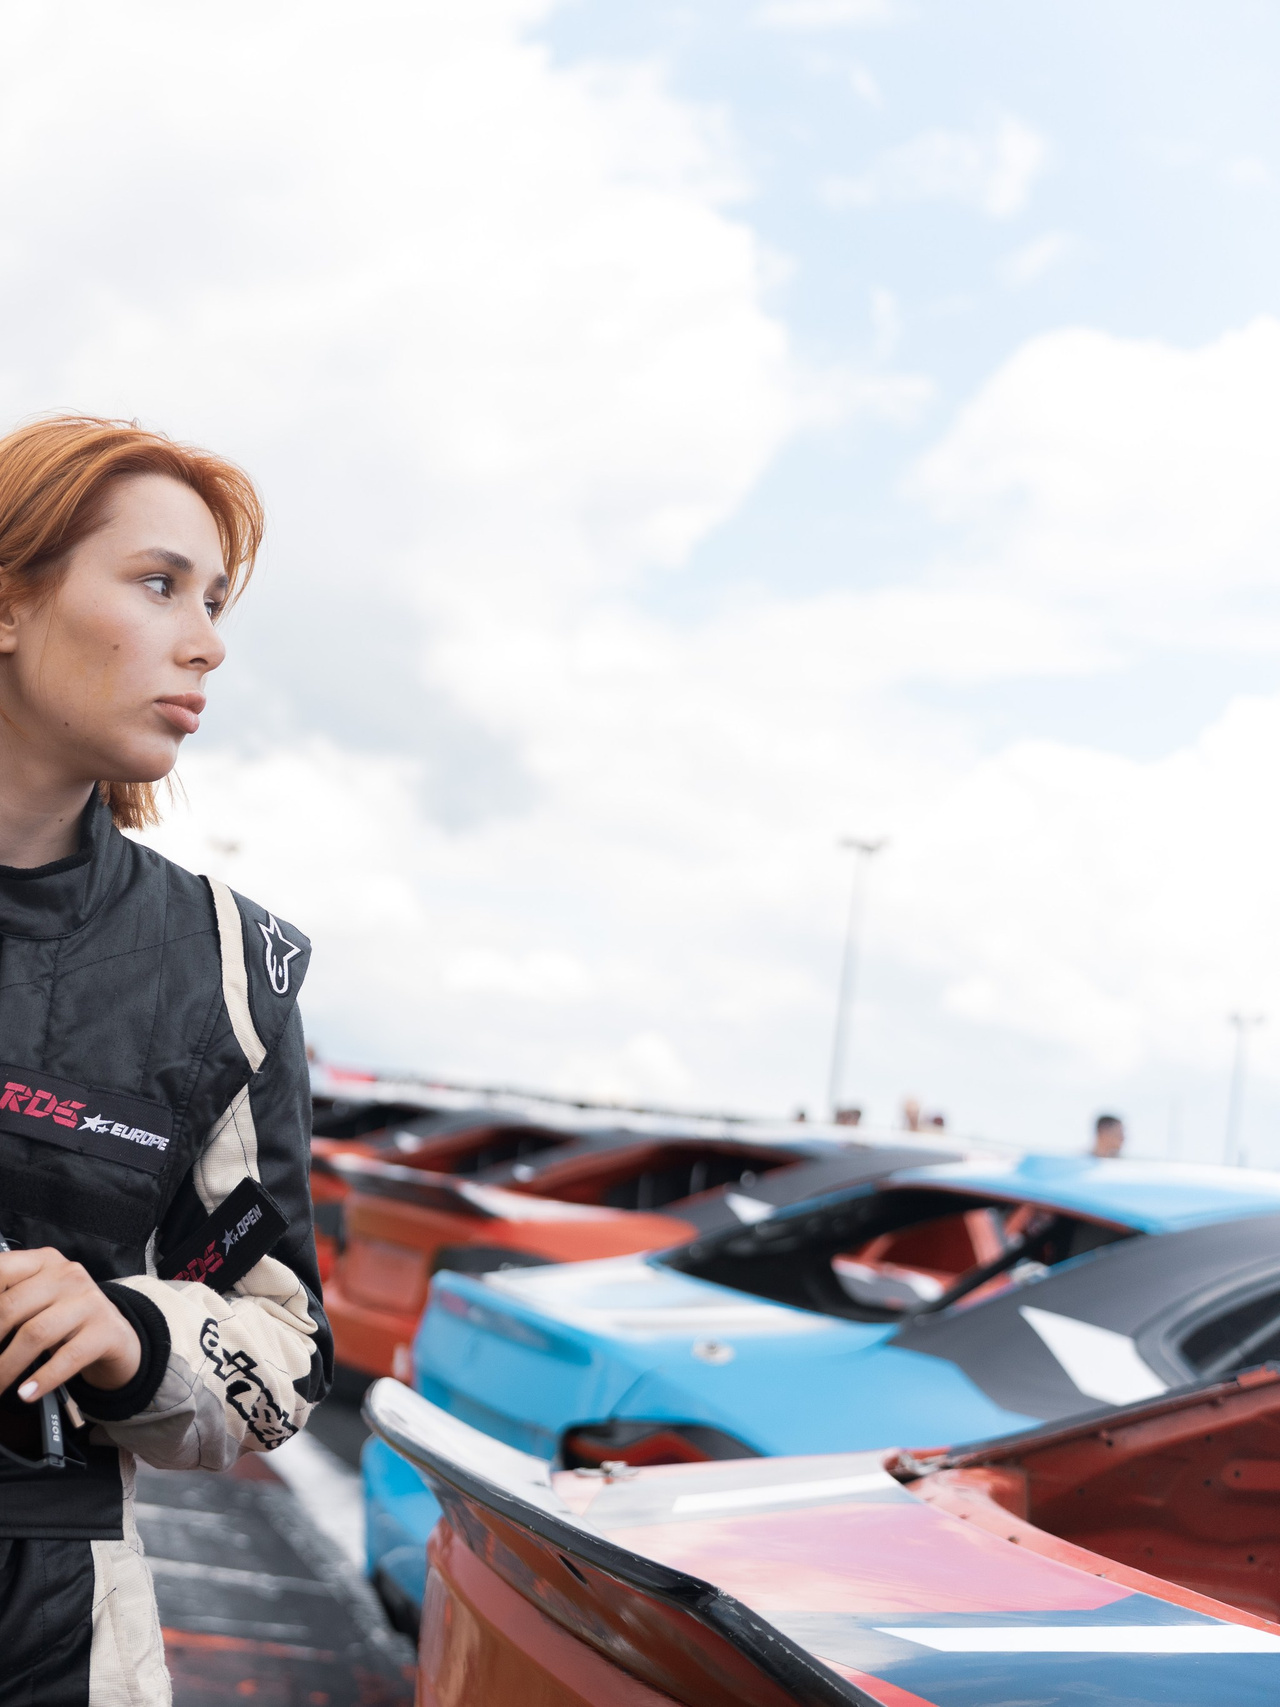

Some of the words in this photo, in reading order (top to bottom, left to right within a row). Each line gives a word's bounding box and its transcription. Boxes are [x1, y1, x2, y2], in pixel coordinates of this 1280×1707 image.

[109, 1122, 170, 1151] EUROPE
[236, 1204, 263, 1237] OPEN
[50, 1413, 61, 1442] BOSS
